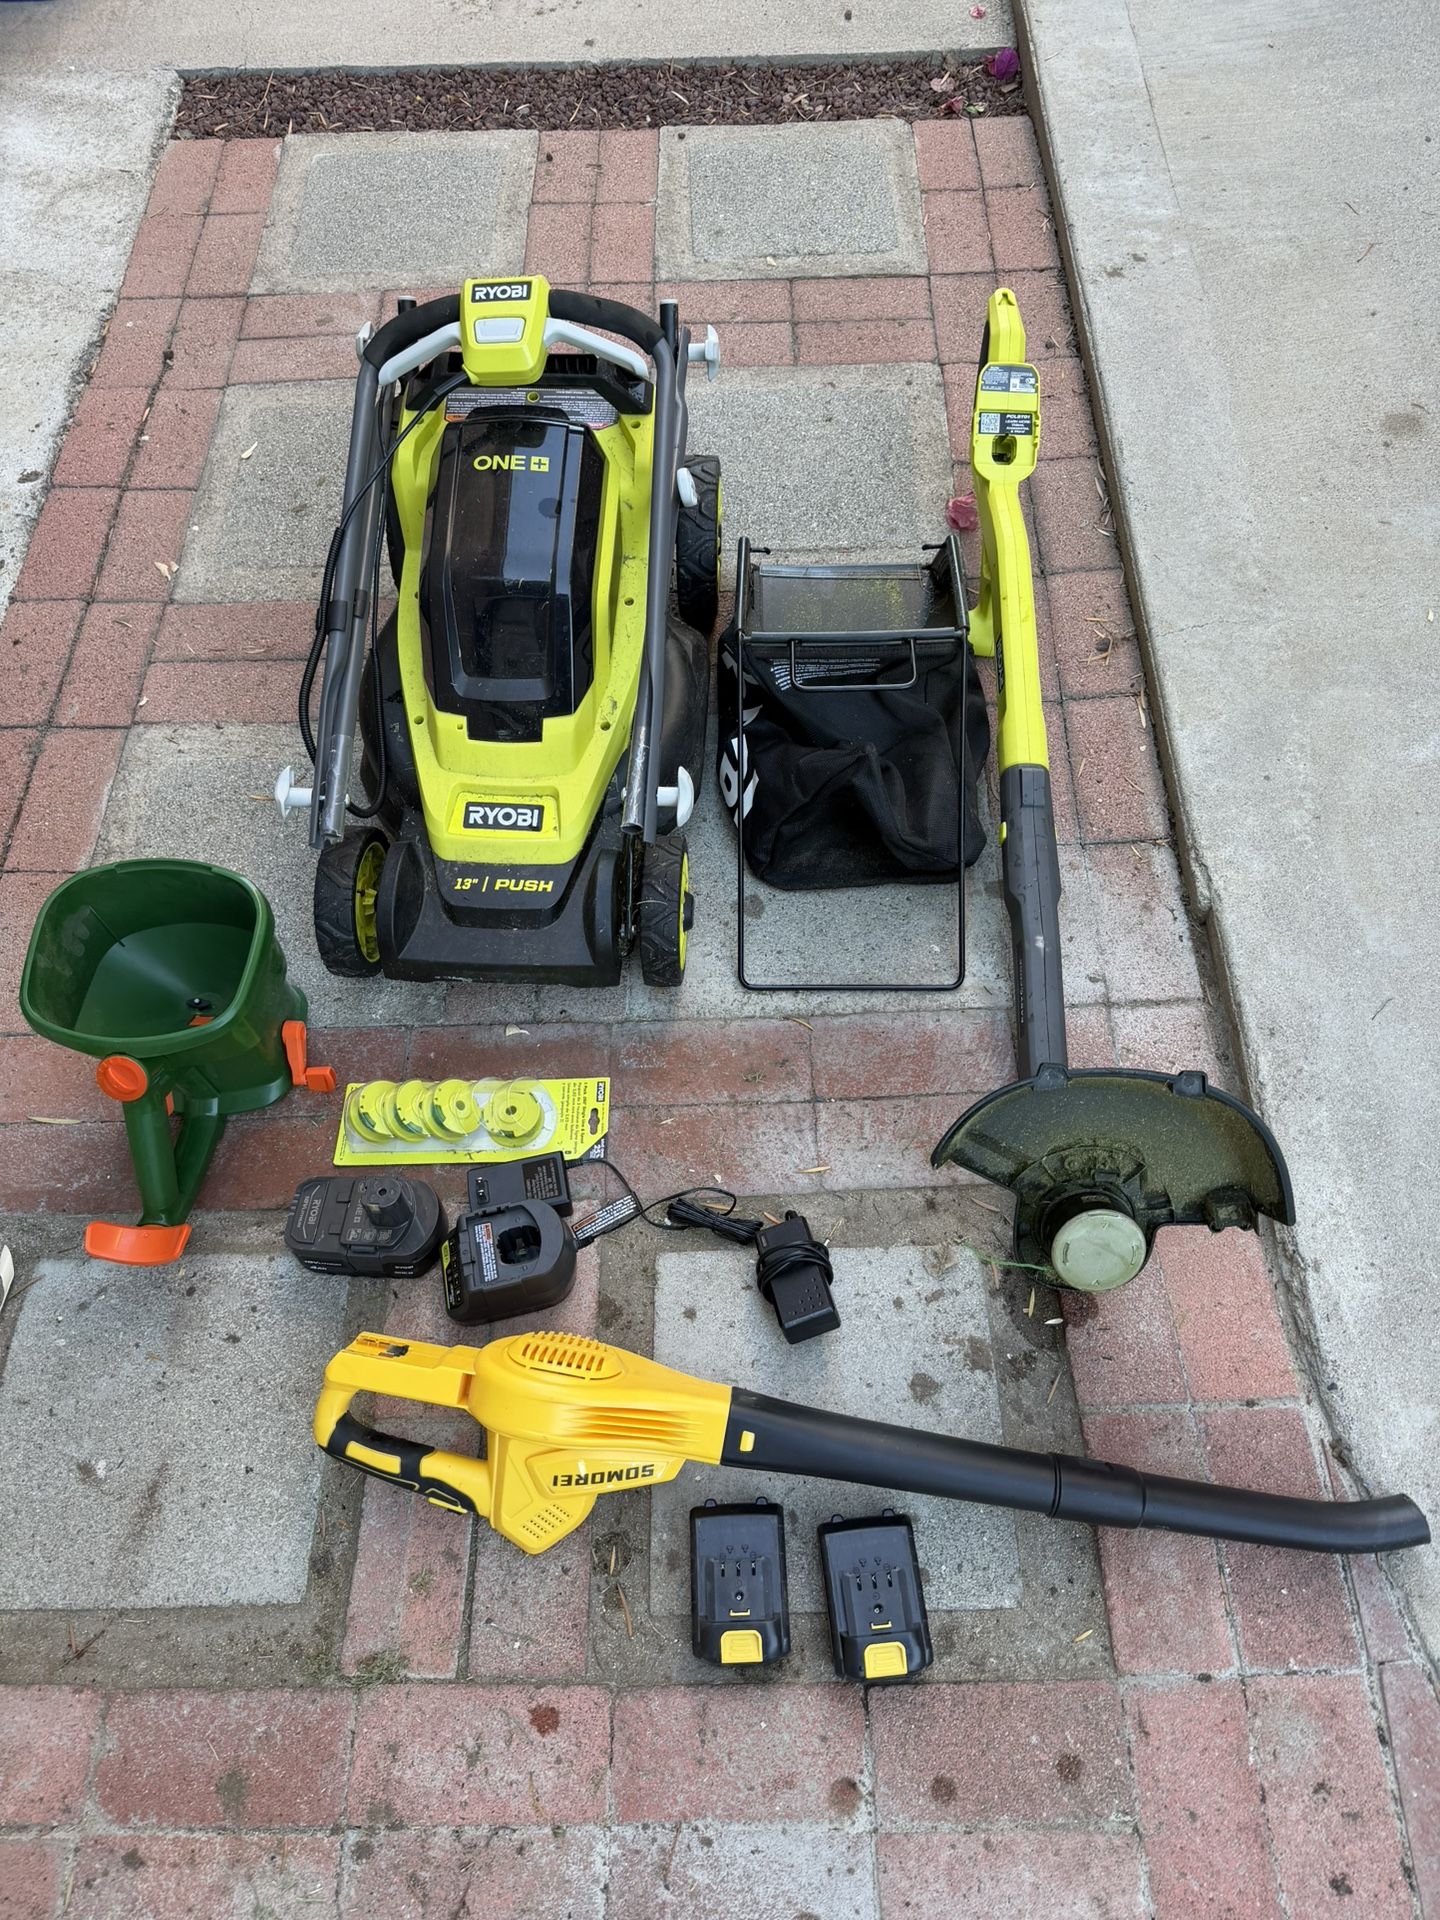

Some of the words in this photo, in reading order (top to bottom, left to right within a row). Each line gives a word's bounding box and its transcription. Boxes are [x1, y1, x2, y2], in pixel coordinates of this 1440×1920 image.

[474, 284, 528, 300] RYOBI
[468, 806, 540, 827] RYOBI
[454, 877, 478, 890] 13"
[494, 878, 554, 892] PUSH
[308, 1198, 322, 1225] RYOBI
[552, 1463, 655, 1487] SOMOREI
